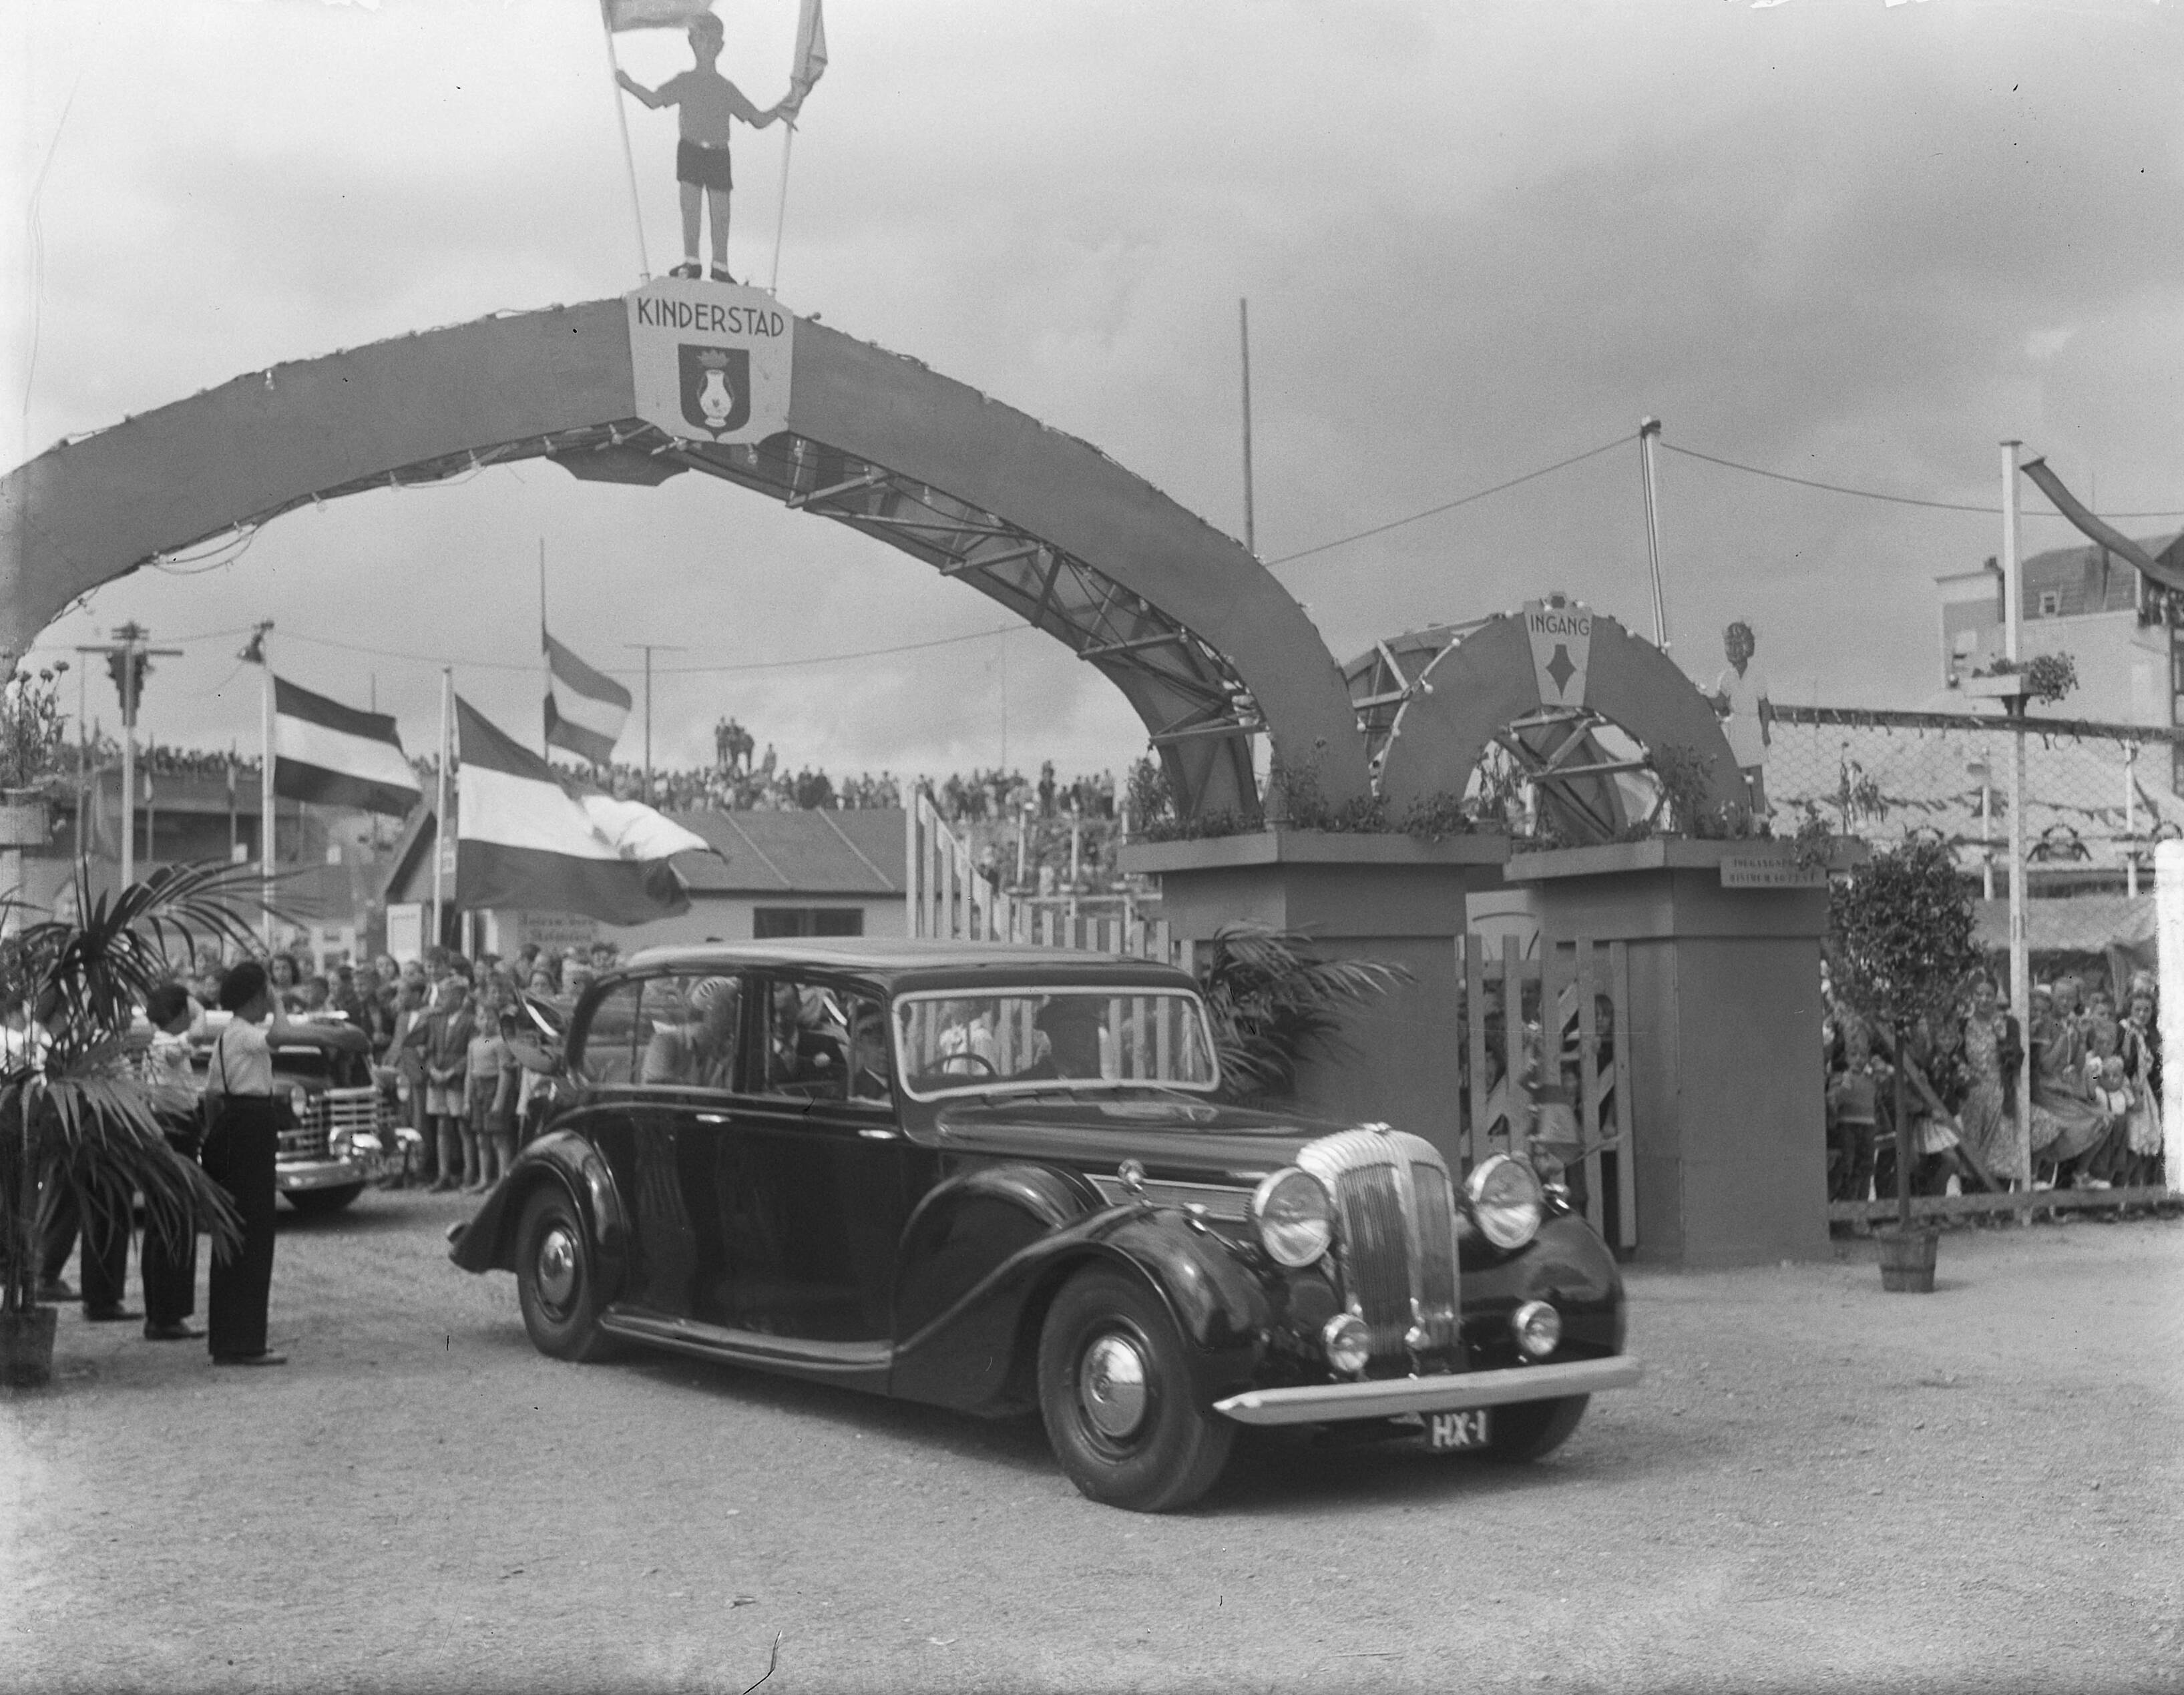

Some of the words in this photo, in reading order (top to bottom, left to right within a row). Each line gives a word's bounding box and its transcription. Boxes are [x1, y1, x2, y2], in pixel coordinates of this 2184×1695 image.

[638, 298, 785, 337] KINDERSTAD
[1530, 614, 1590, 636] INGANG
[1432, 1410, 1486, 1447] HX-1
